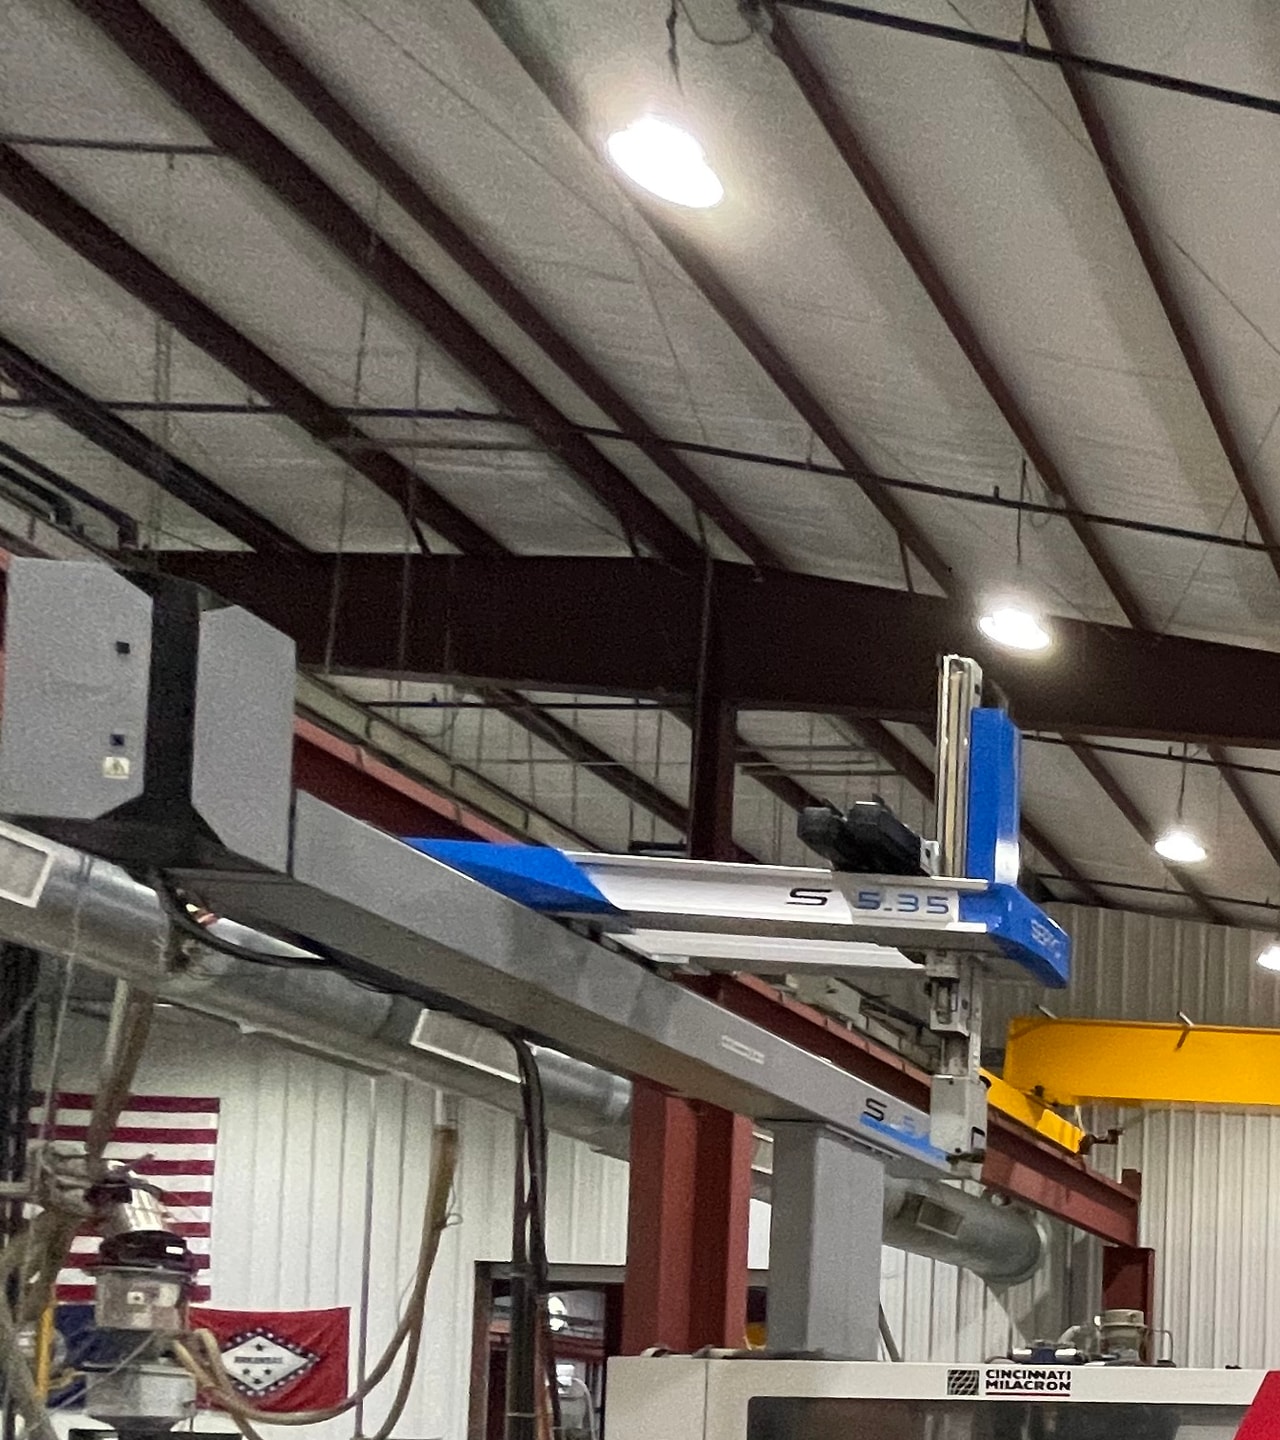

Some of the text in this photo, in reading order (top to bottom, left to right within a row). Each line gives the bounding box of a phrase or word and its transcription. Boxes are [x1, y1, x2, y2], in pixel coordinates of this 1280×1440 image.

[786, 887, 949, 914] S 5.35
[863, 1097, 888, 1121] S
[985, 1369, 1072, 1380] CINCINNATI
[985, 1380, 1072, 1391] MILACRON
